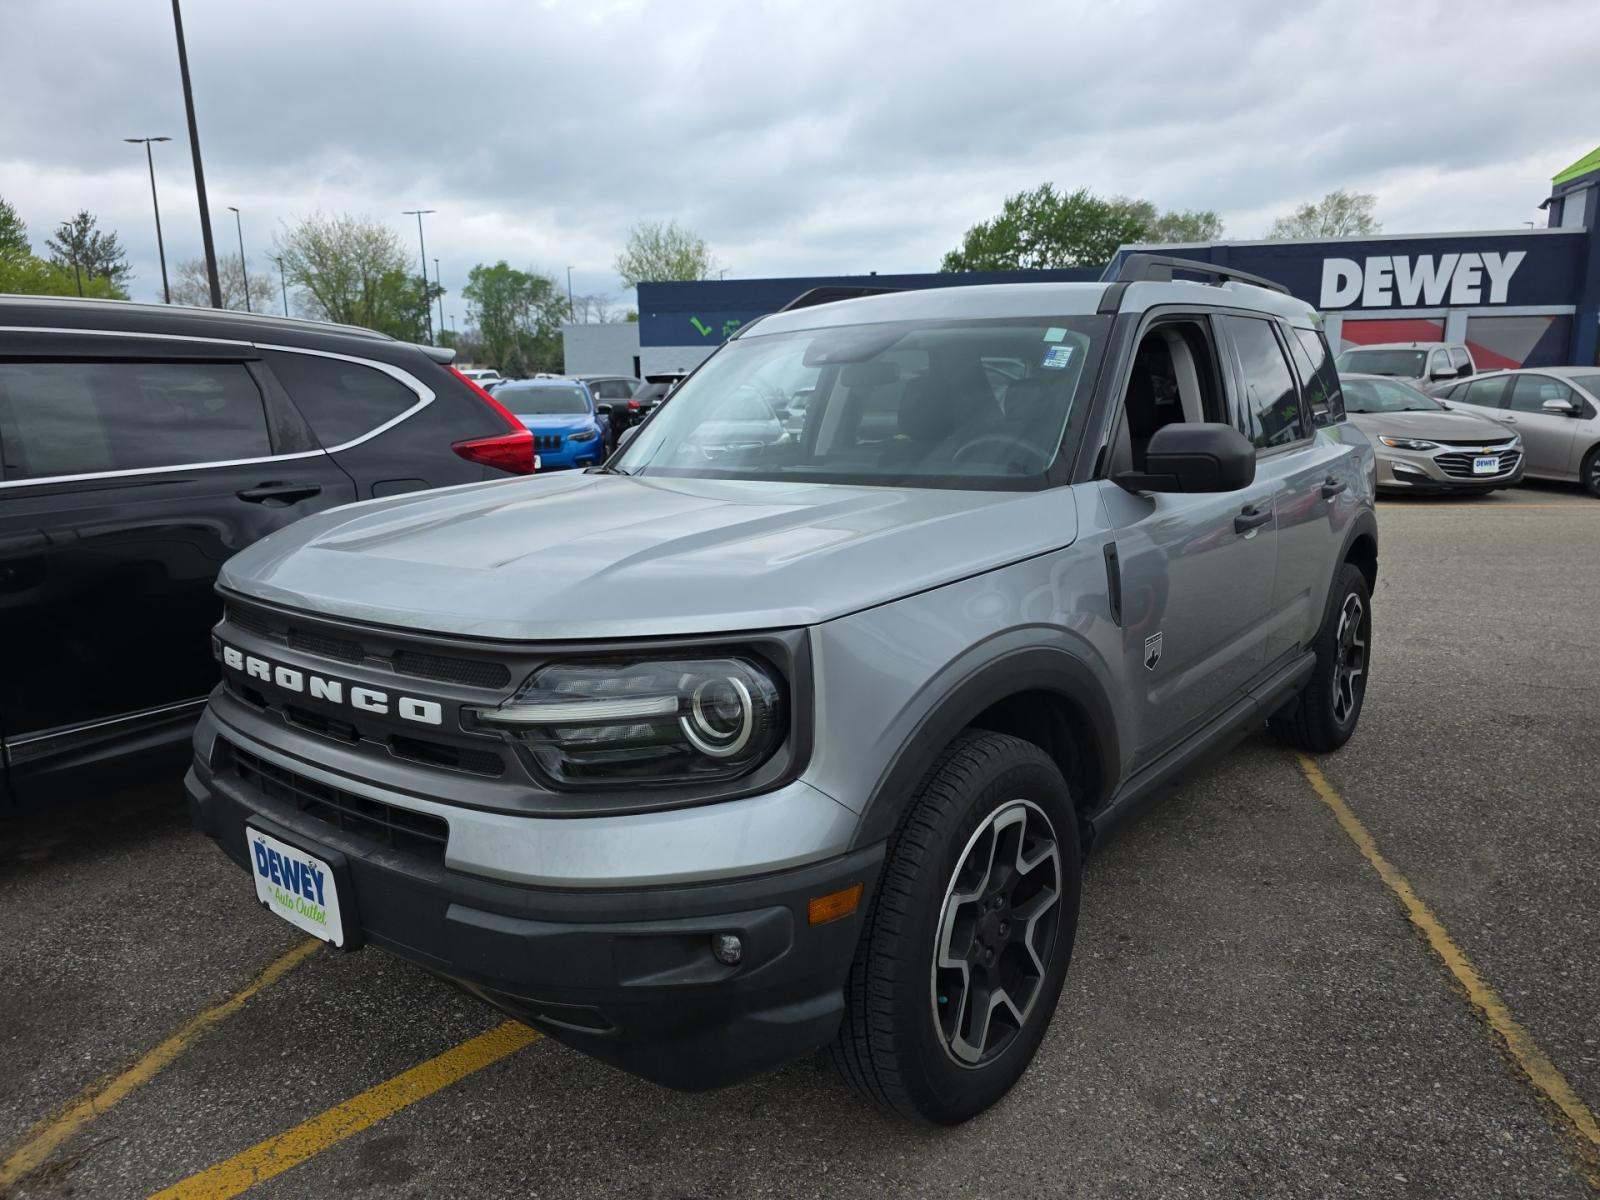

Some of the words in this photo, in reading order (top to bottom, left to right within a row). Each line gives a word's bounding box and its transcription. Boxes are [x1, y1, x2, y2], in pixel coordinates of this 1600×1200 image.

[1320, 251, 1527, 308] DEWEY
[223, 646, 442, 725] BRONCO
[253, 840, 325, 906] DEWEY
[275, 888, 294, 910] Auto
[296, 896, 327, 925] Outlet
